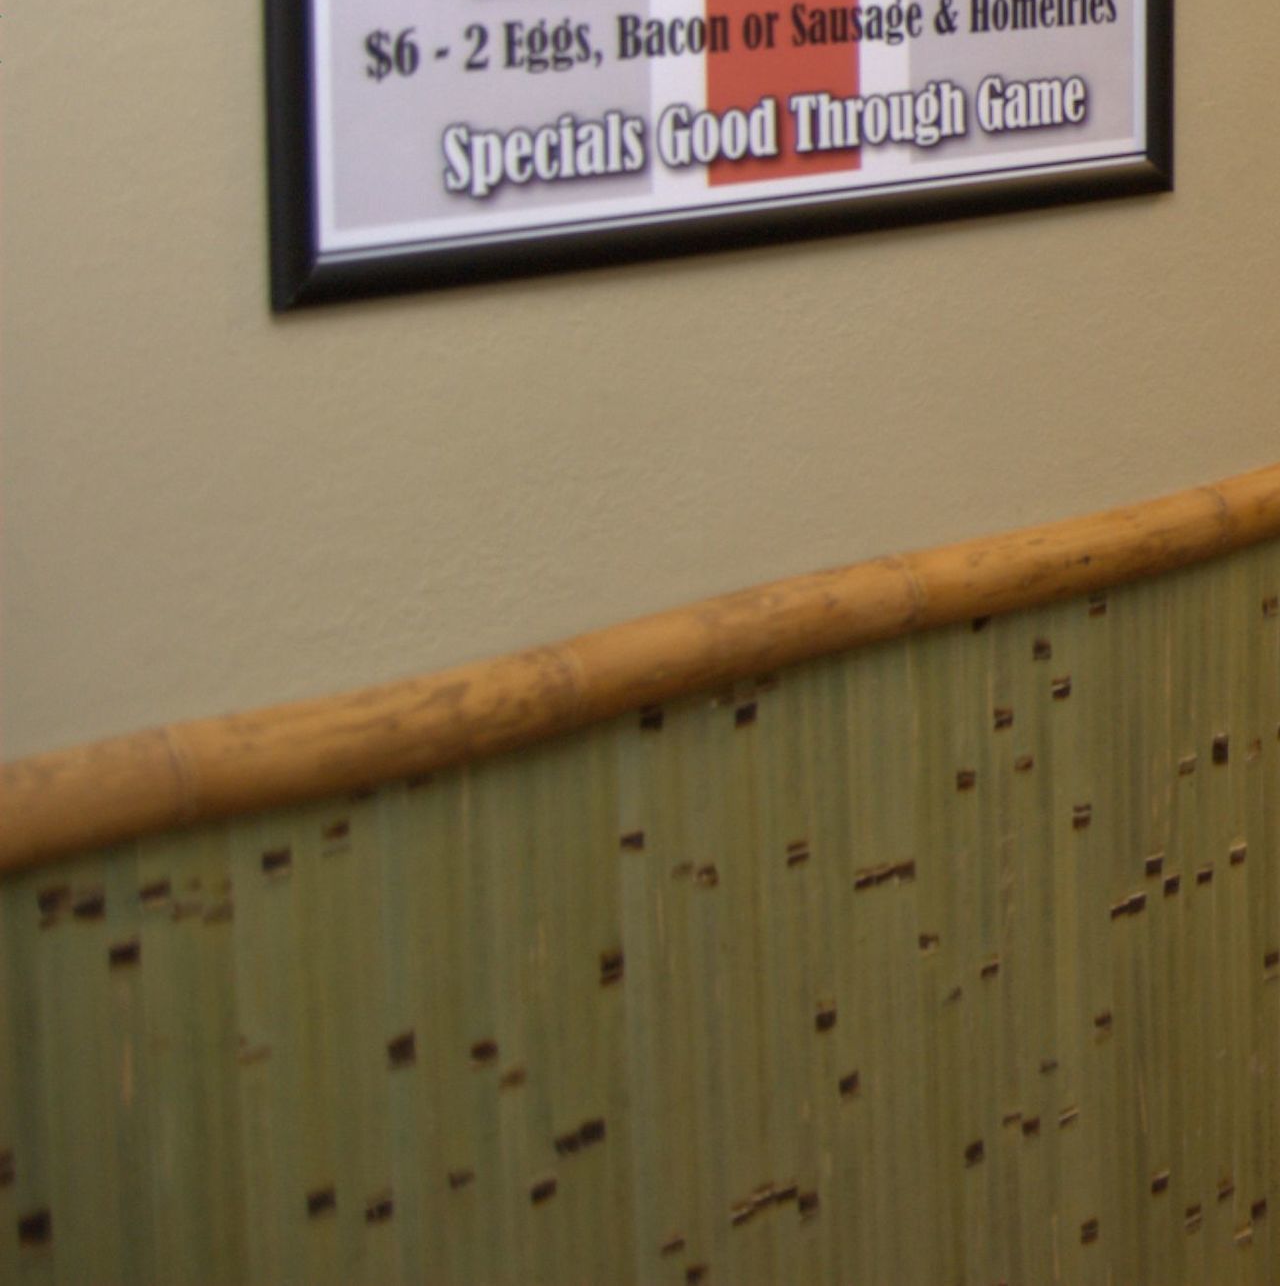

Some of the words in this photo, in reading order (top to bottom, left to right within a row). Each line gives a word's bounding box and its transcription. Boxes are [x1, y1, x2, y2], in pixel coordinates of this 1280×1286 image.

[365, 27, 421, 82] $6
[464, 23, 490, 72] 2
[503, 17, 604, 75] Eggs,
[617, 13, 731, 61] Bacon
[742, 12, 780, 51] or
[442, 109, 646, 198] Specials
[657, 98, 779, 166] Good
[790, 80, 967, 154] Through
[977, 75, 1087, 132] Game
